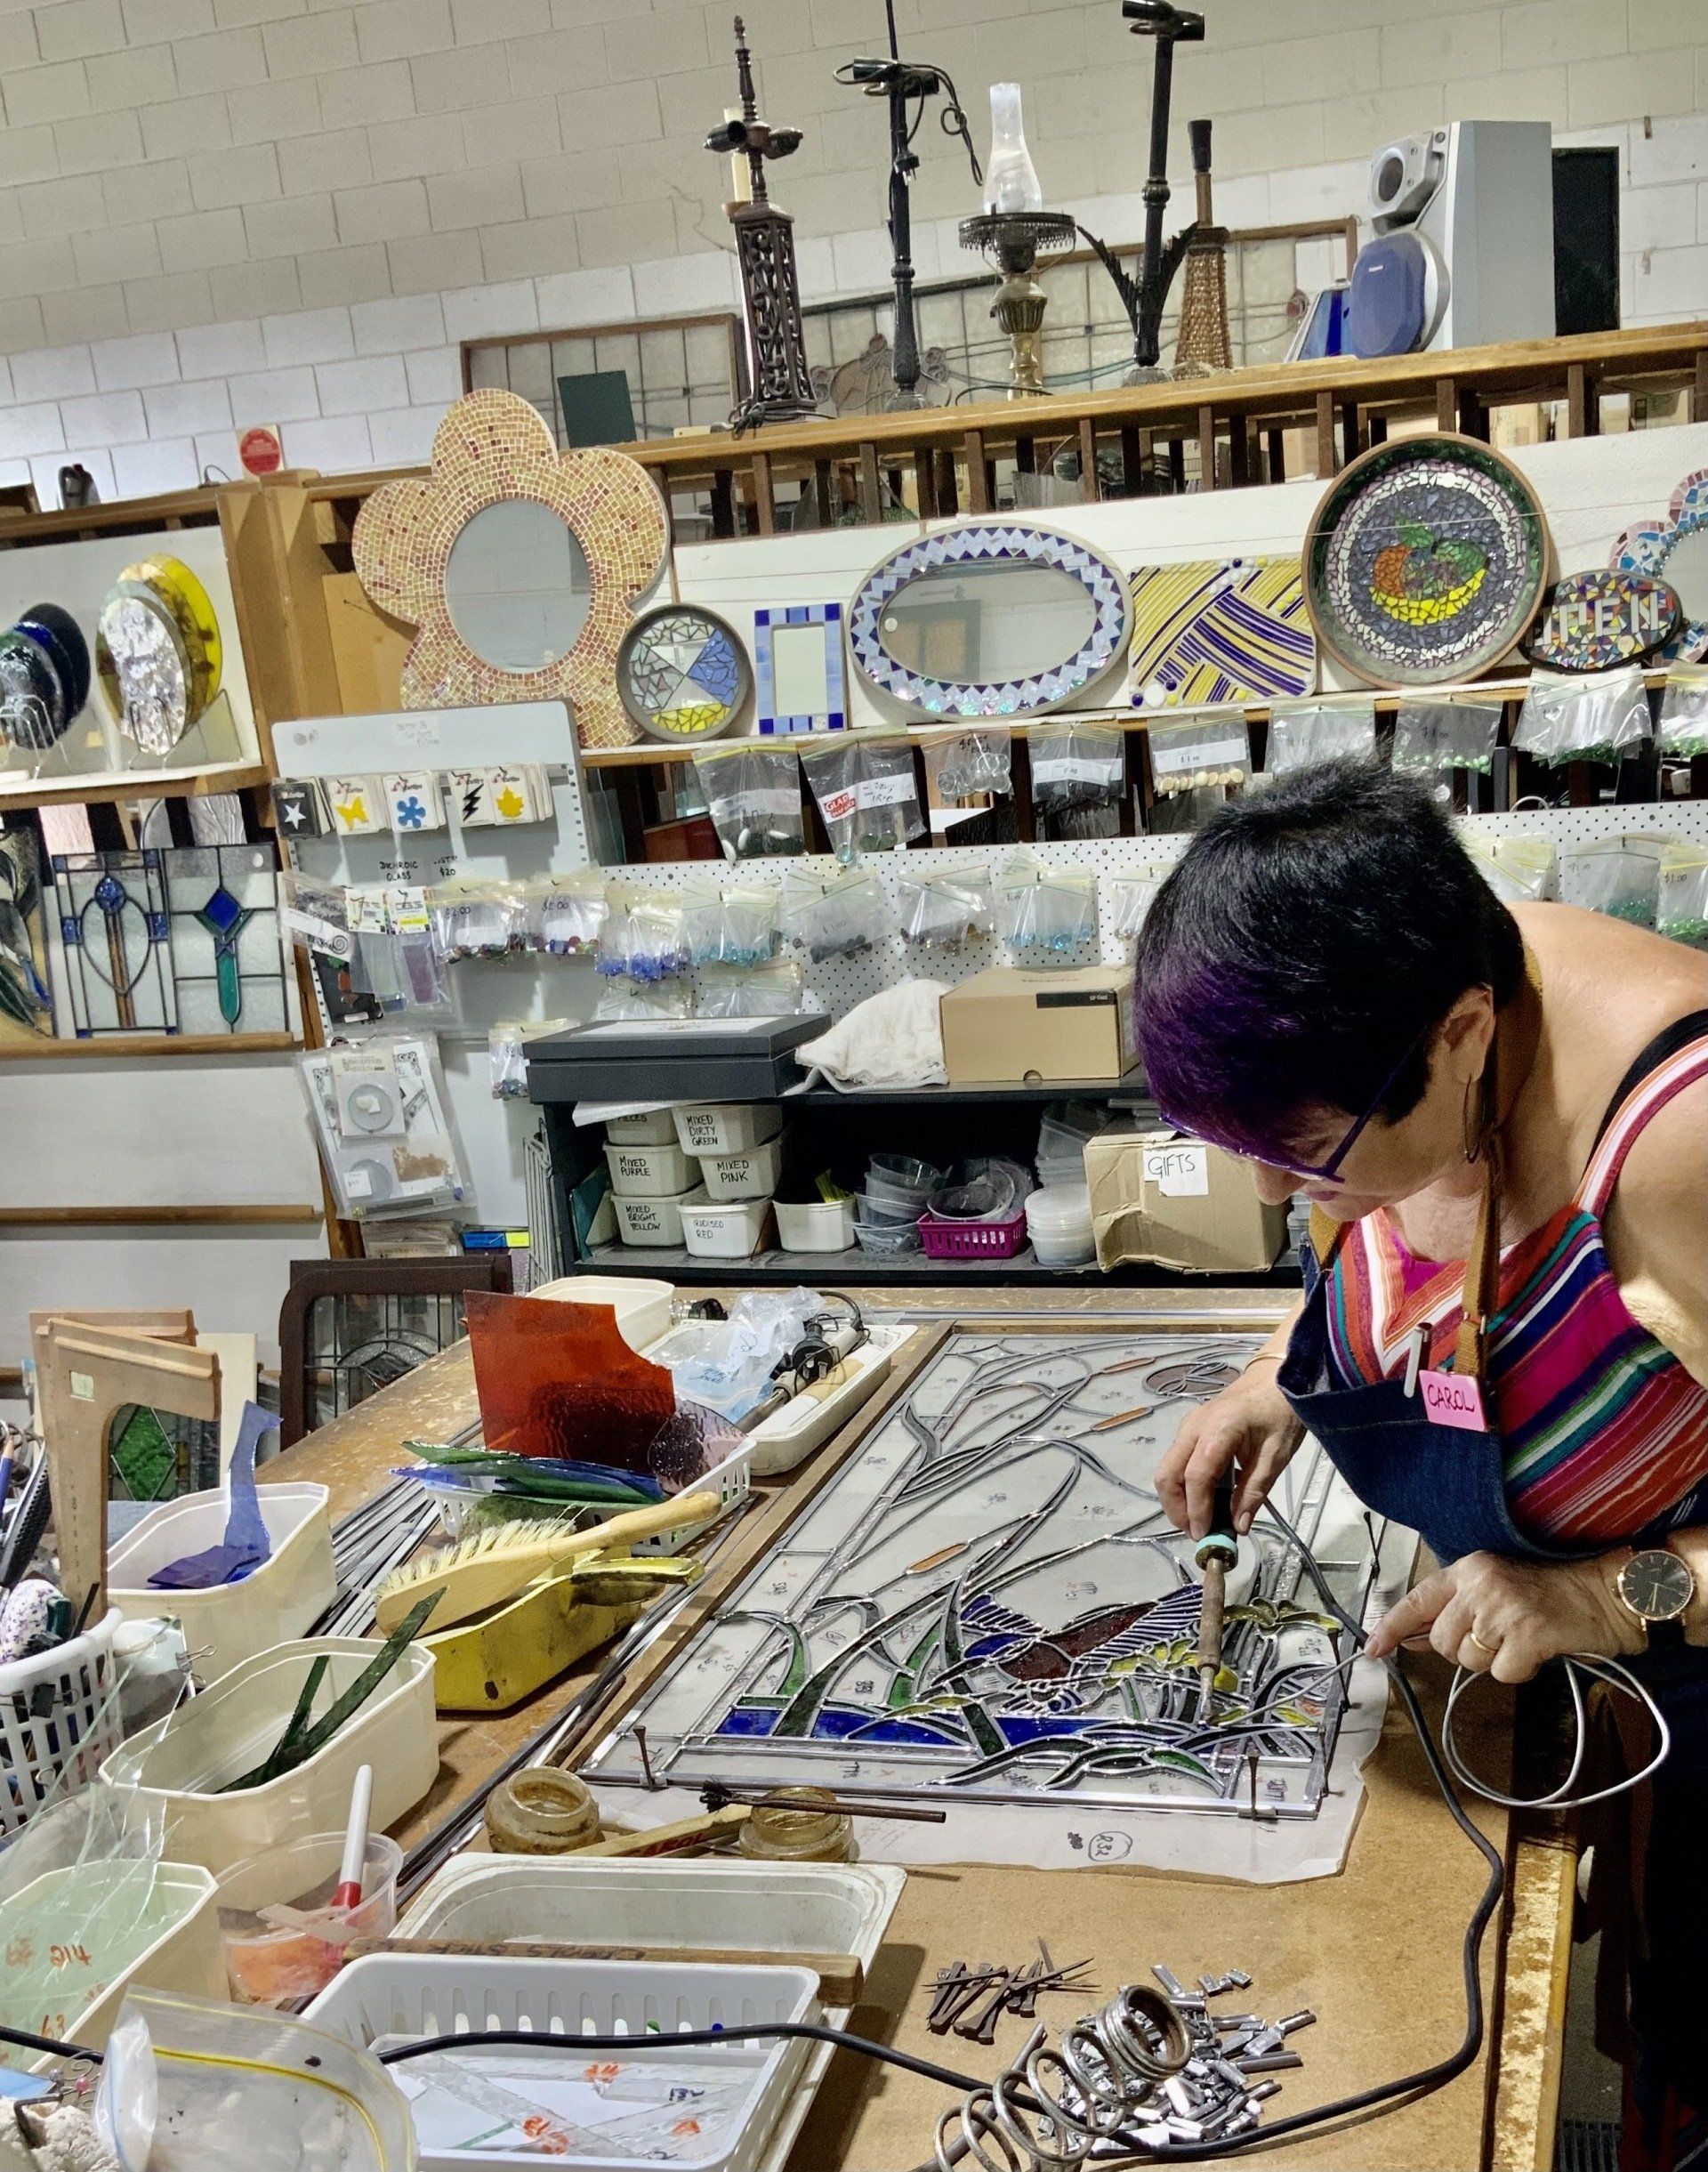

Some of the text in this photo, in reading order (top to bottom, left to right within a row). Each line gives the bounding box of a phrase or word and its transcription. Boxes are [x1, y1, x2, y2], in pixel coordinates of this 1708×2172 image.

[825, 793, 849, 811] GLAD
[379, 860, 419, 869] DICHROIC
[386, 872, 412, 882] GLASS
[686, 1114, 713, 1126] MIXED
[689, 1126, 715, 1137] DIRTY
[691, 1136, 719, 1147] GREEN
[619, 1155, 647, 1167] MIXED
[717, 1159, 750, 1172] MIXED
[1147, 1153, 1196, 1179] GIFTS
[620, 1167, 651, 1176] PURPLE
[720, 1171, 749, 1183] PINK
[625, 1205, 651, 1214] MIXED
[627, 1213, 657, 1222] BRIGHT
[629, 1223, 661, 1231] YELLOW
[696, 1230, 713, 1239] RED
[1427, 1384, 1475, 1413] CAROL
